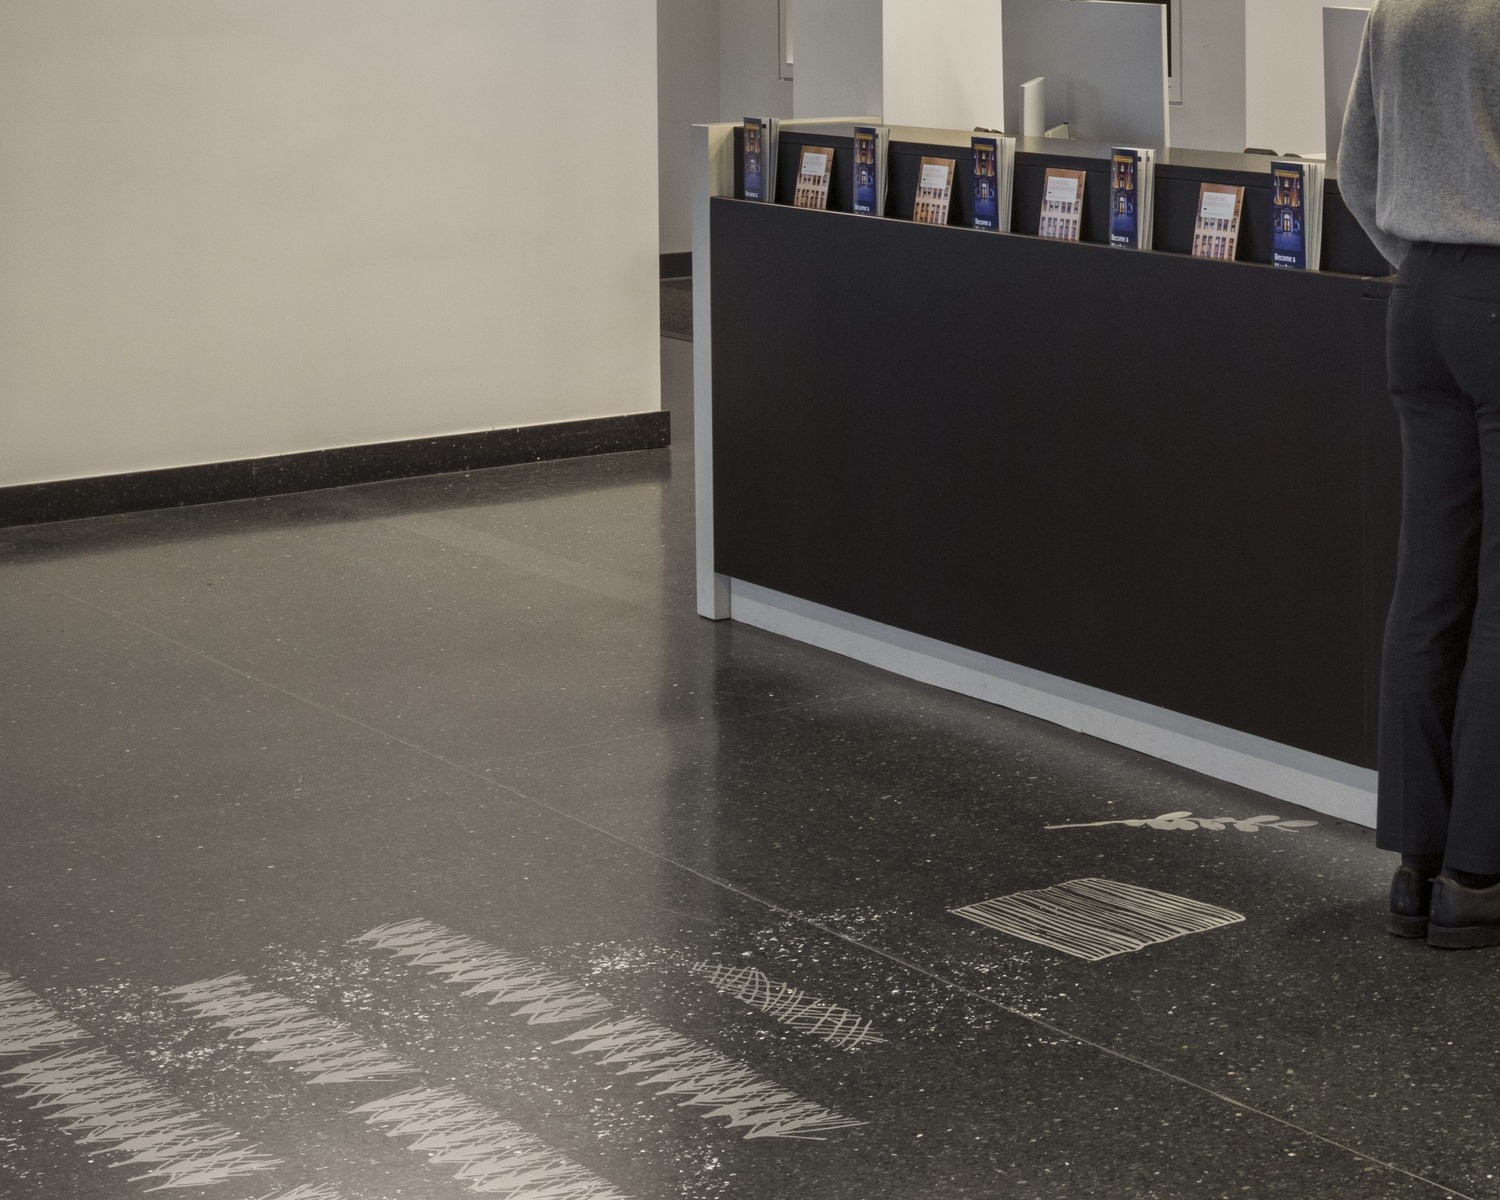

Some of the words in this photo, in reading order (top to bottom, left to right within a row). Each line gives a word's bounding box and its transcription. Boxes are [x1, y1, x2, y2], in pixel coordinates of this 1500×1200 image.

[975, 218, 988, 226] Become
[1111, 234, 1125, 243] Become
[1274, 253, 1292, 262] Become
